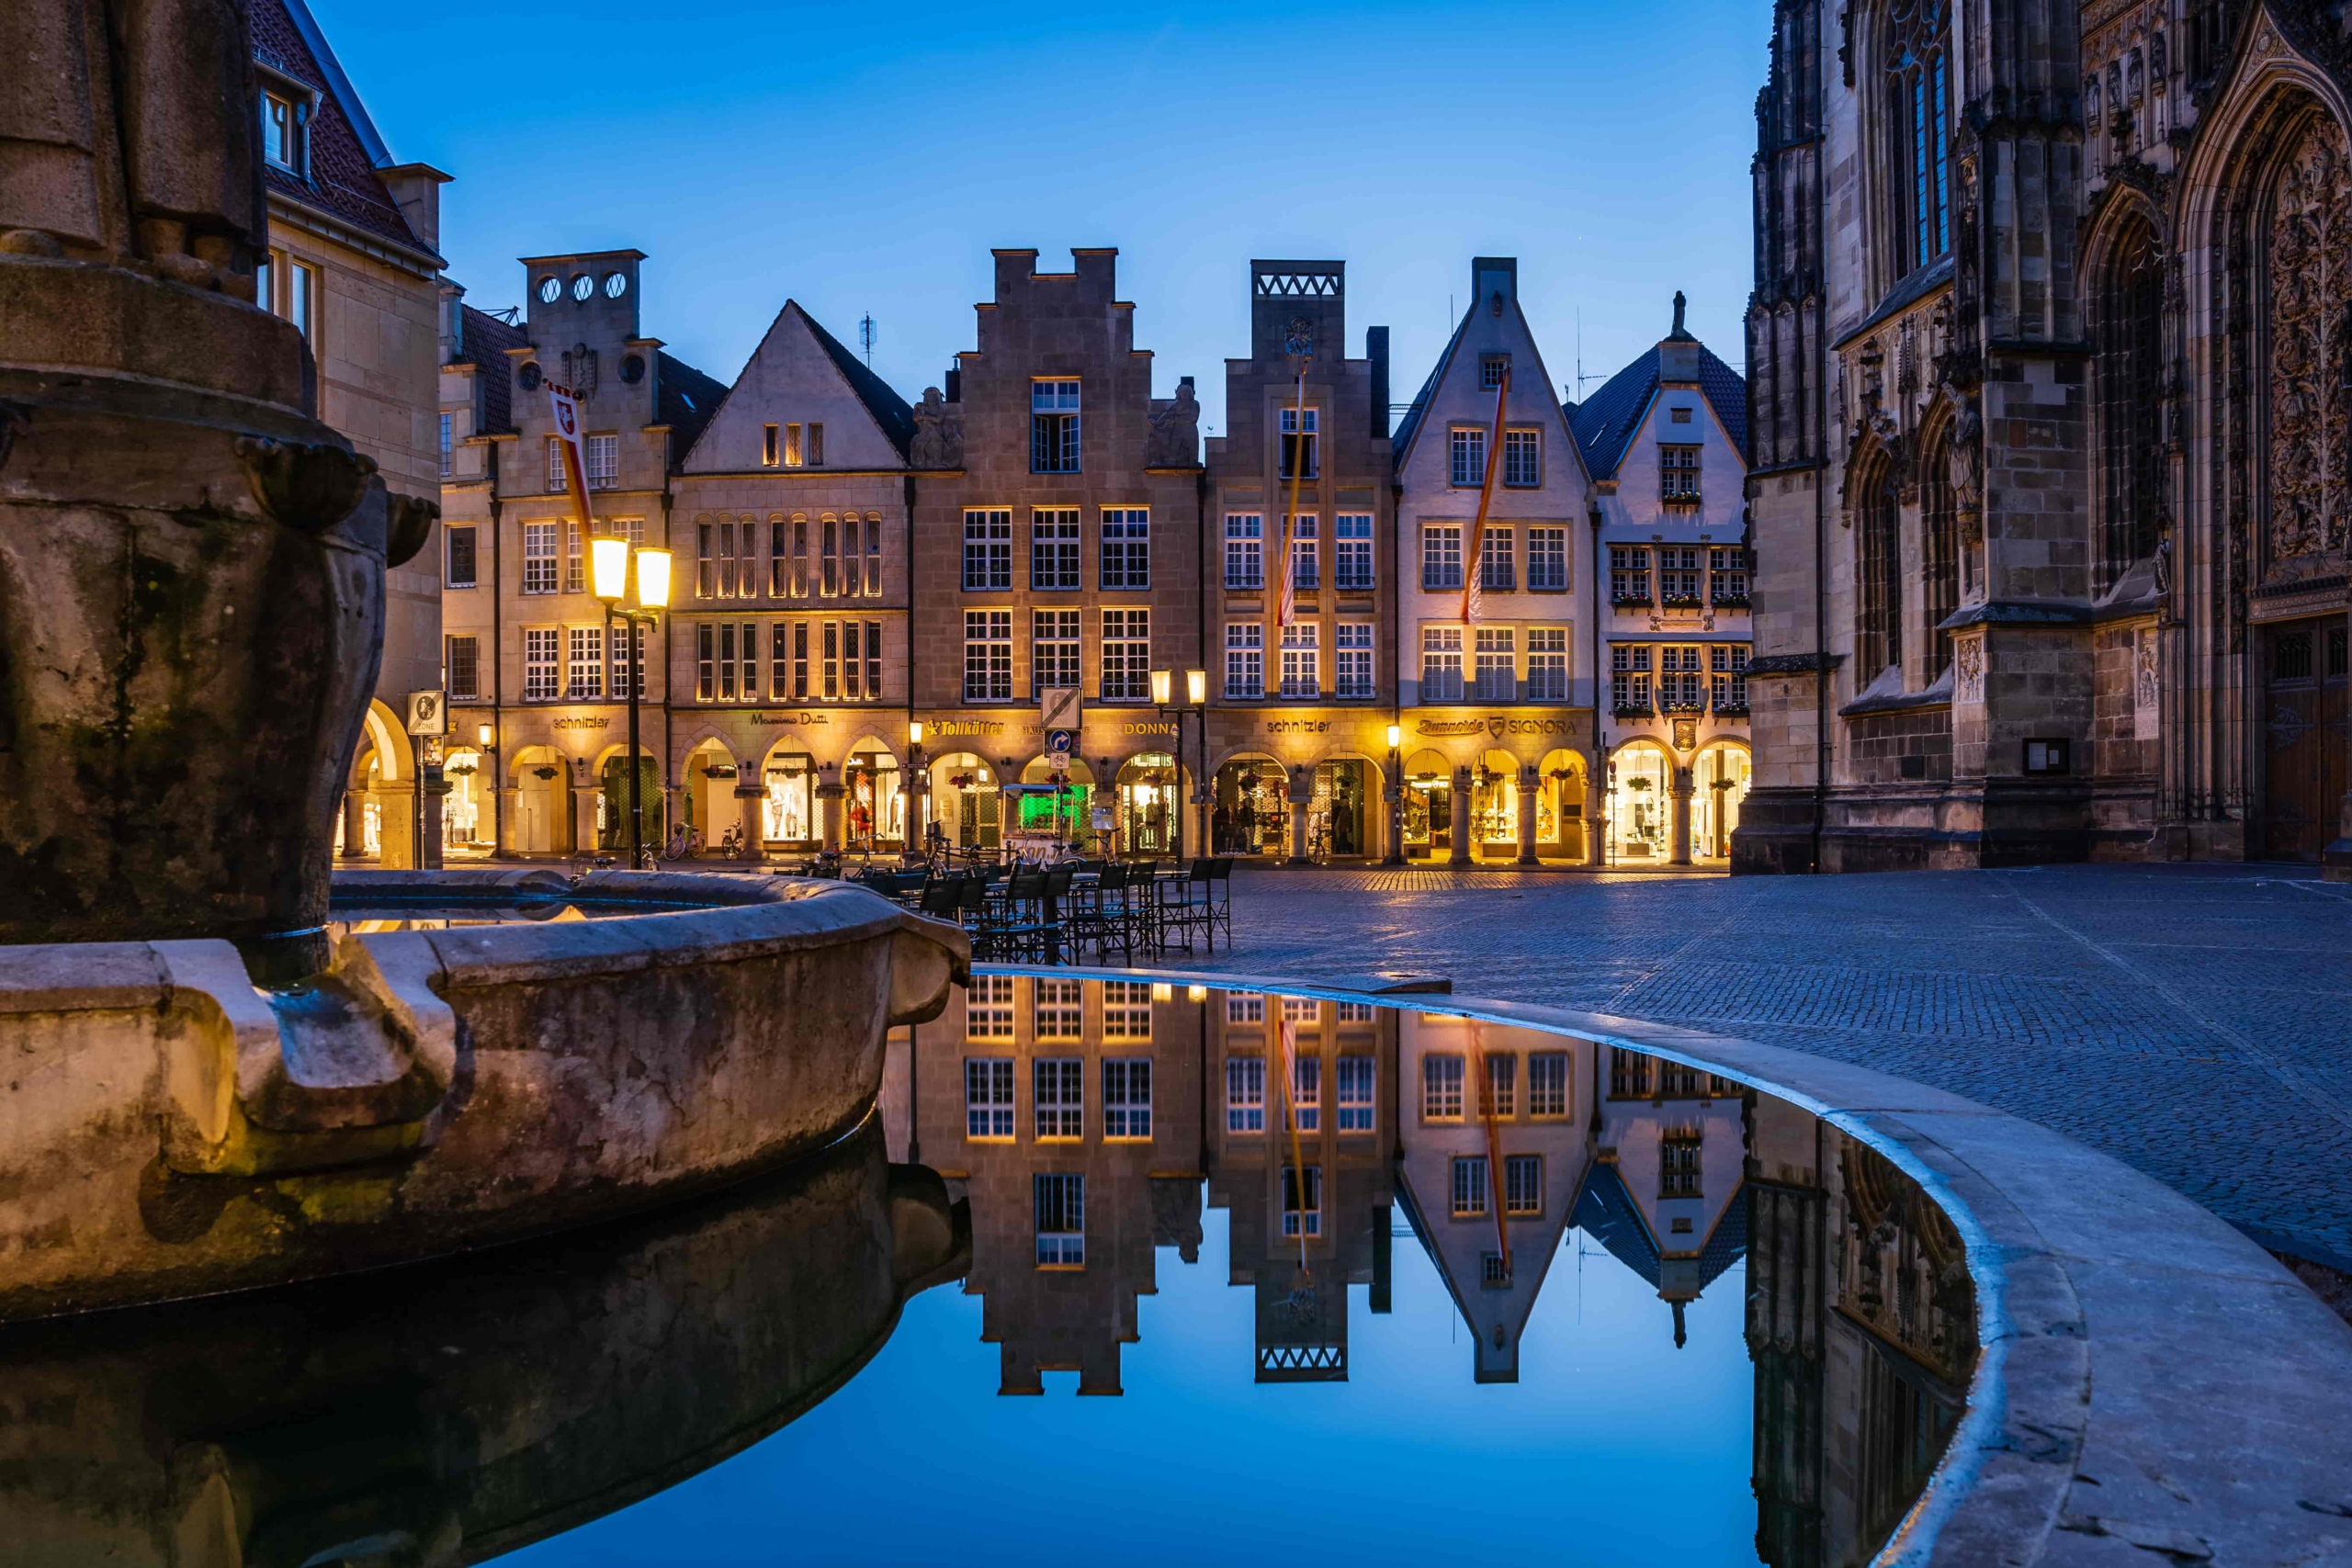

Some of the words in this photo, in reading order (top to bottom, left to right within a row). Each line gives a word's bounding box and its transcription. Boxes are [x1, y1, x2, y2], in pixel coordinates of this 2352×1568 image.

[553, 716, 610, 729] schnitzler
[800, 712, 829, 725] Dutti
[941, 719, 1004, 736] Tollkötter
[1125, 723, 1179, 735] DONNA
[1267, 719, 1332, 733] schnitzler
[1508, 719, 1577, 734] SIGNORA
